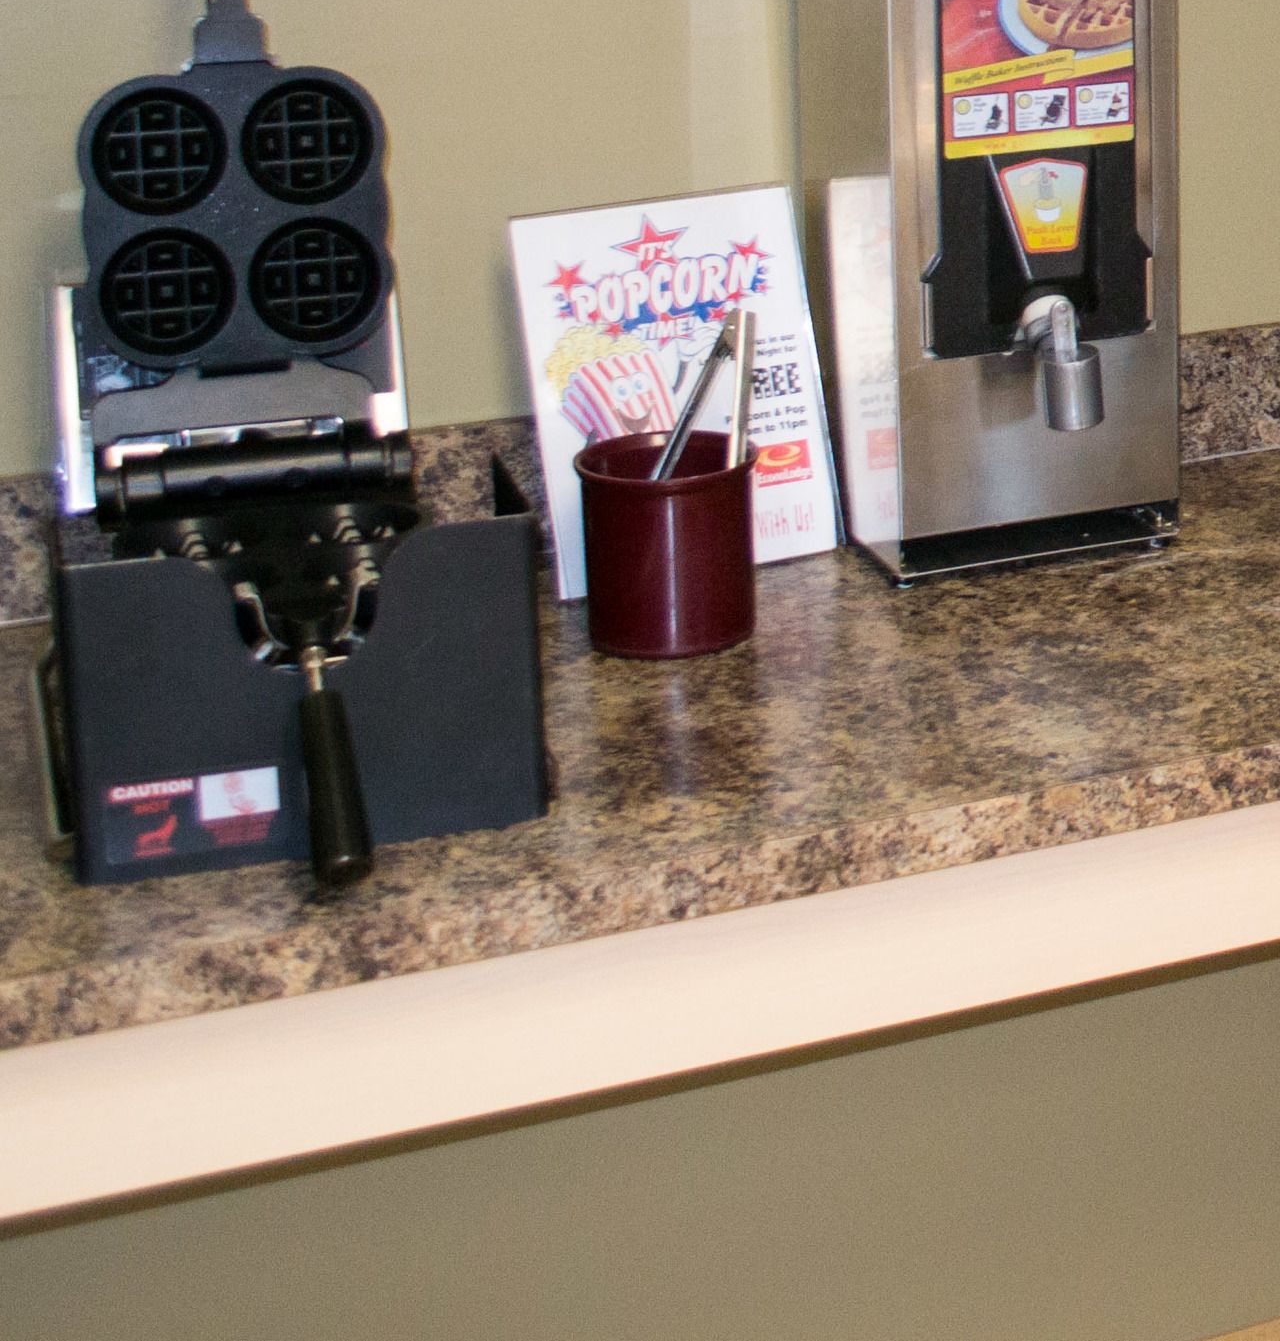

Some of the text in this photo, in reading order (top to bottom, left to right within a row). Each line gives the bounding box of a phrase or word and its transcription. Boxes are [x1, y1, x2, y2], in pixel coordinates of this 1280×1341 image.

[638, 239, 674, 260] IT'S
[571, 251, 759, 324] POPCORN
[637, 311, 696, 341] TIME!
[753, 362, 802, 400] REE
[785, 404, 806, 417] Pop
[112, 778, 194, 800] CAUTION
